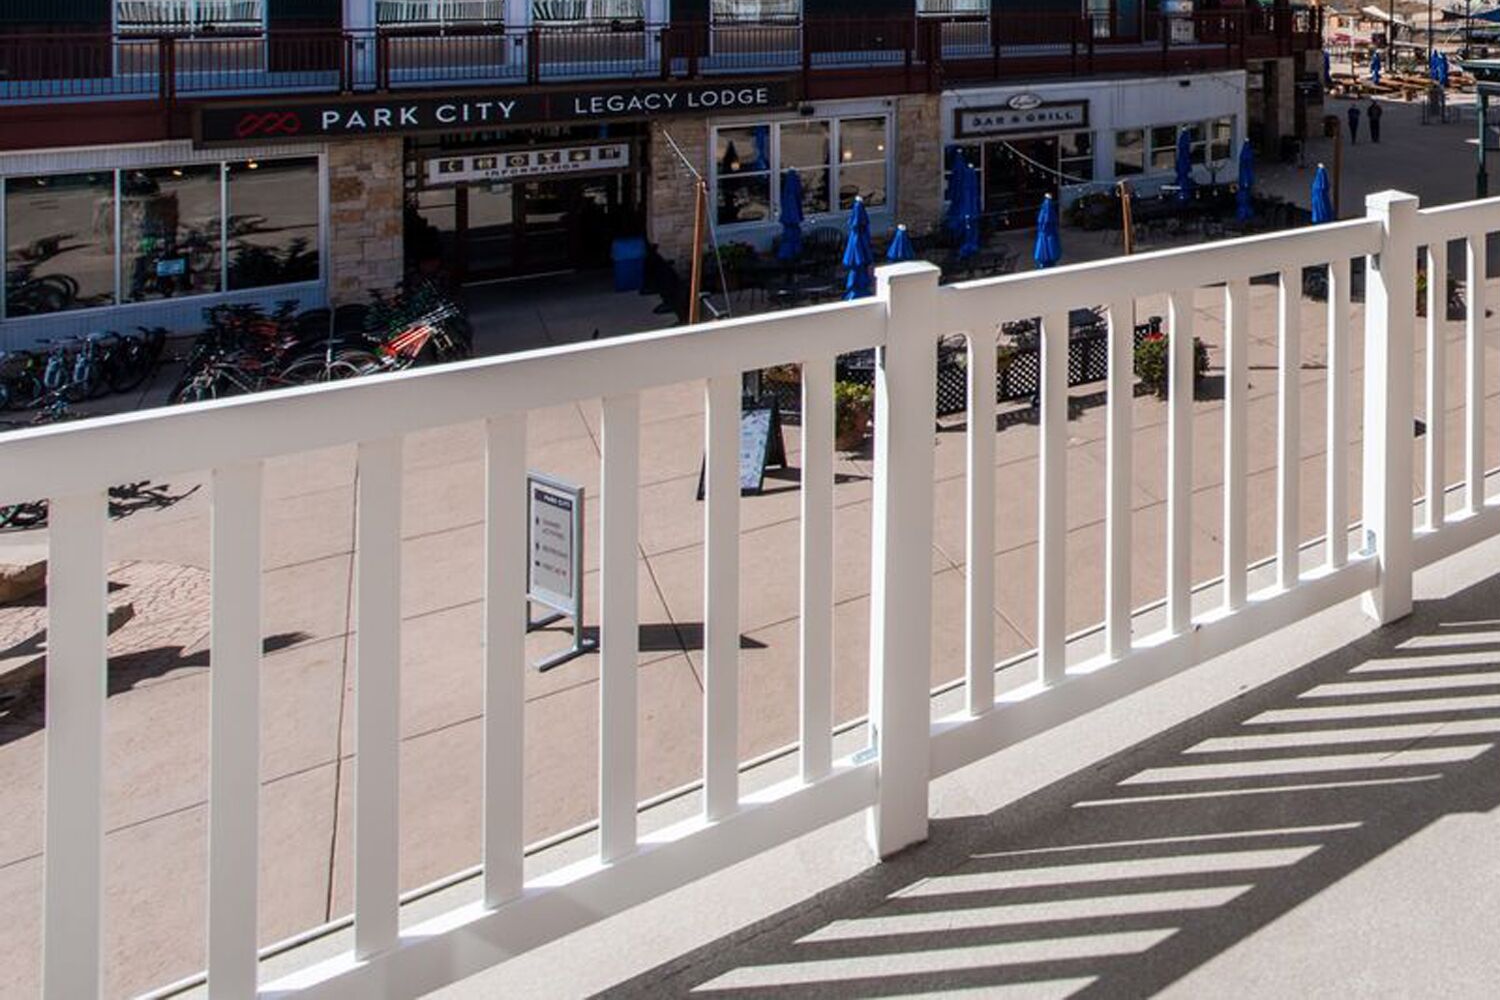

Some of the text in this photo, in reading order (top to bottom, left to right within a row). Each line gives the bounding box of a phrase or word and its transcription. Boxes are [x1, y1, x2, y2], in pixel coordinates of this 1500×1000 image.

[575, 87, 769, 114] LEGACY LODGE
[321, 101, 516, 131] PARK CITY
[972, 116, 1005, 127] BAR
[1026, 111, 1075, 122] GRILL
[485, 163, 580, 177] INFORMATION
